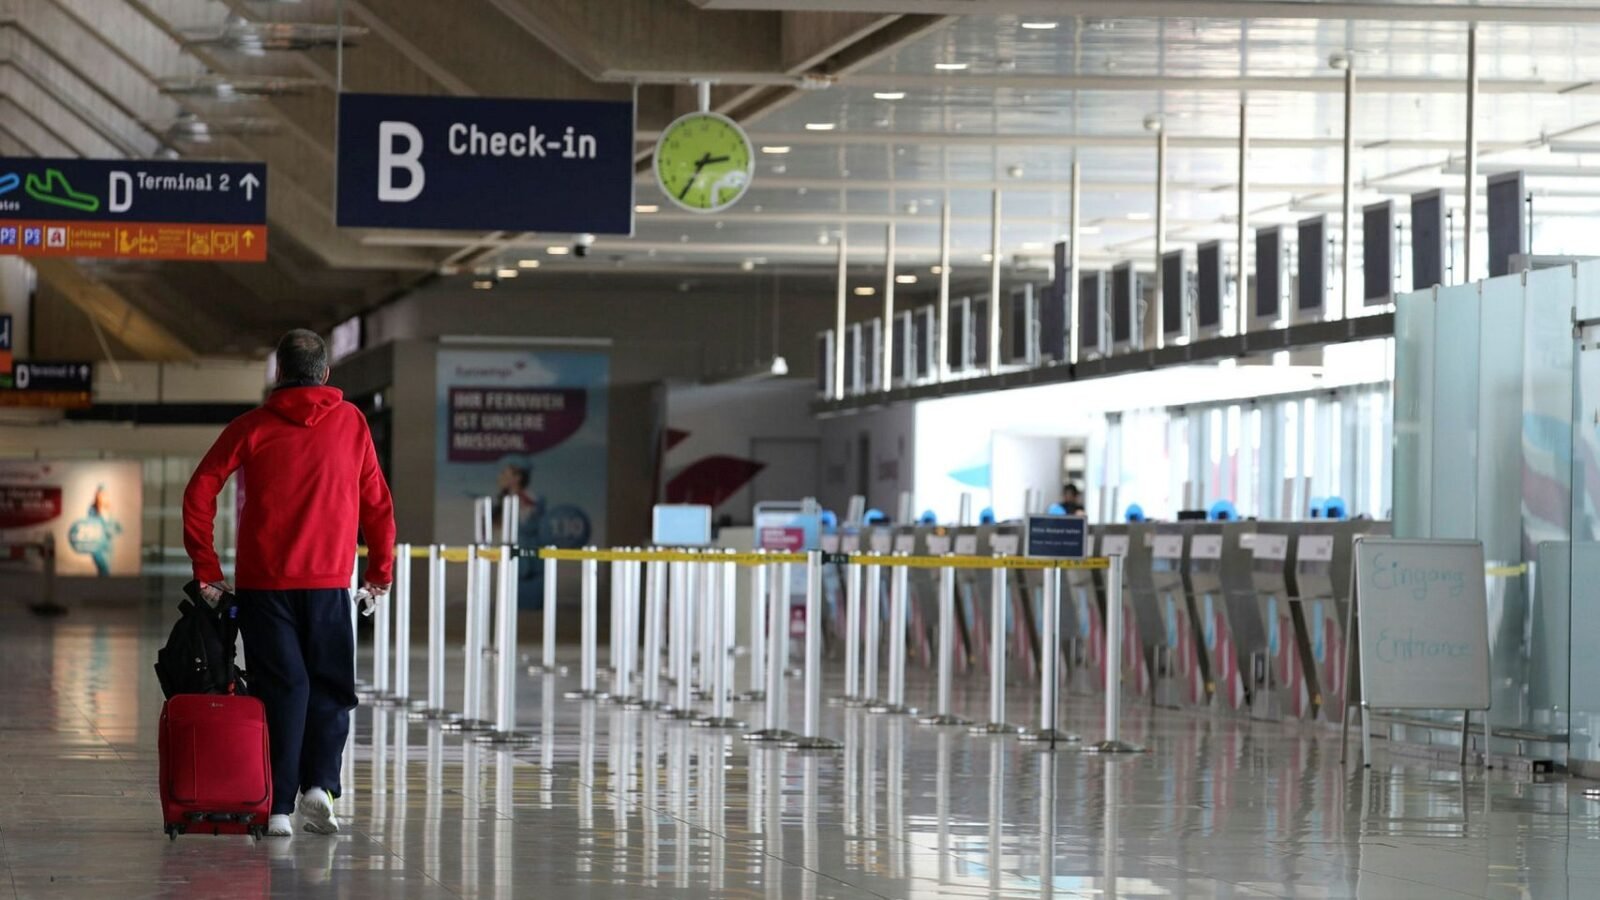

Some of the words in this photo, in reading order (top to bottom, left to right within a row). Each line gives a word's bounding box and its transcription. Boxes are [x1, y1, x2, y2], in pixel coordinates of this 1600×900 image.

[449, 122, 596, 159] Check-in
[378, 120, 425, 202] B
[109, 171, 133, 213] D
[137, 172, 212, 191] Terminal
[220, 174, 230, 191] 2
[454, 392, 482, 410] IHR
[485, 393, 565, 411] FERNWEH
[453, 412, 478, 430] IST
[481, 413, 545, 432] UNSERE
[1371, 552, 1465, 601] Eingang
[1375, 629, 1473, 664] Entrance
